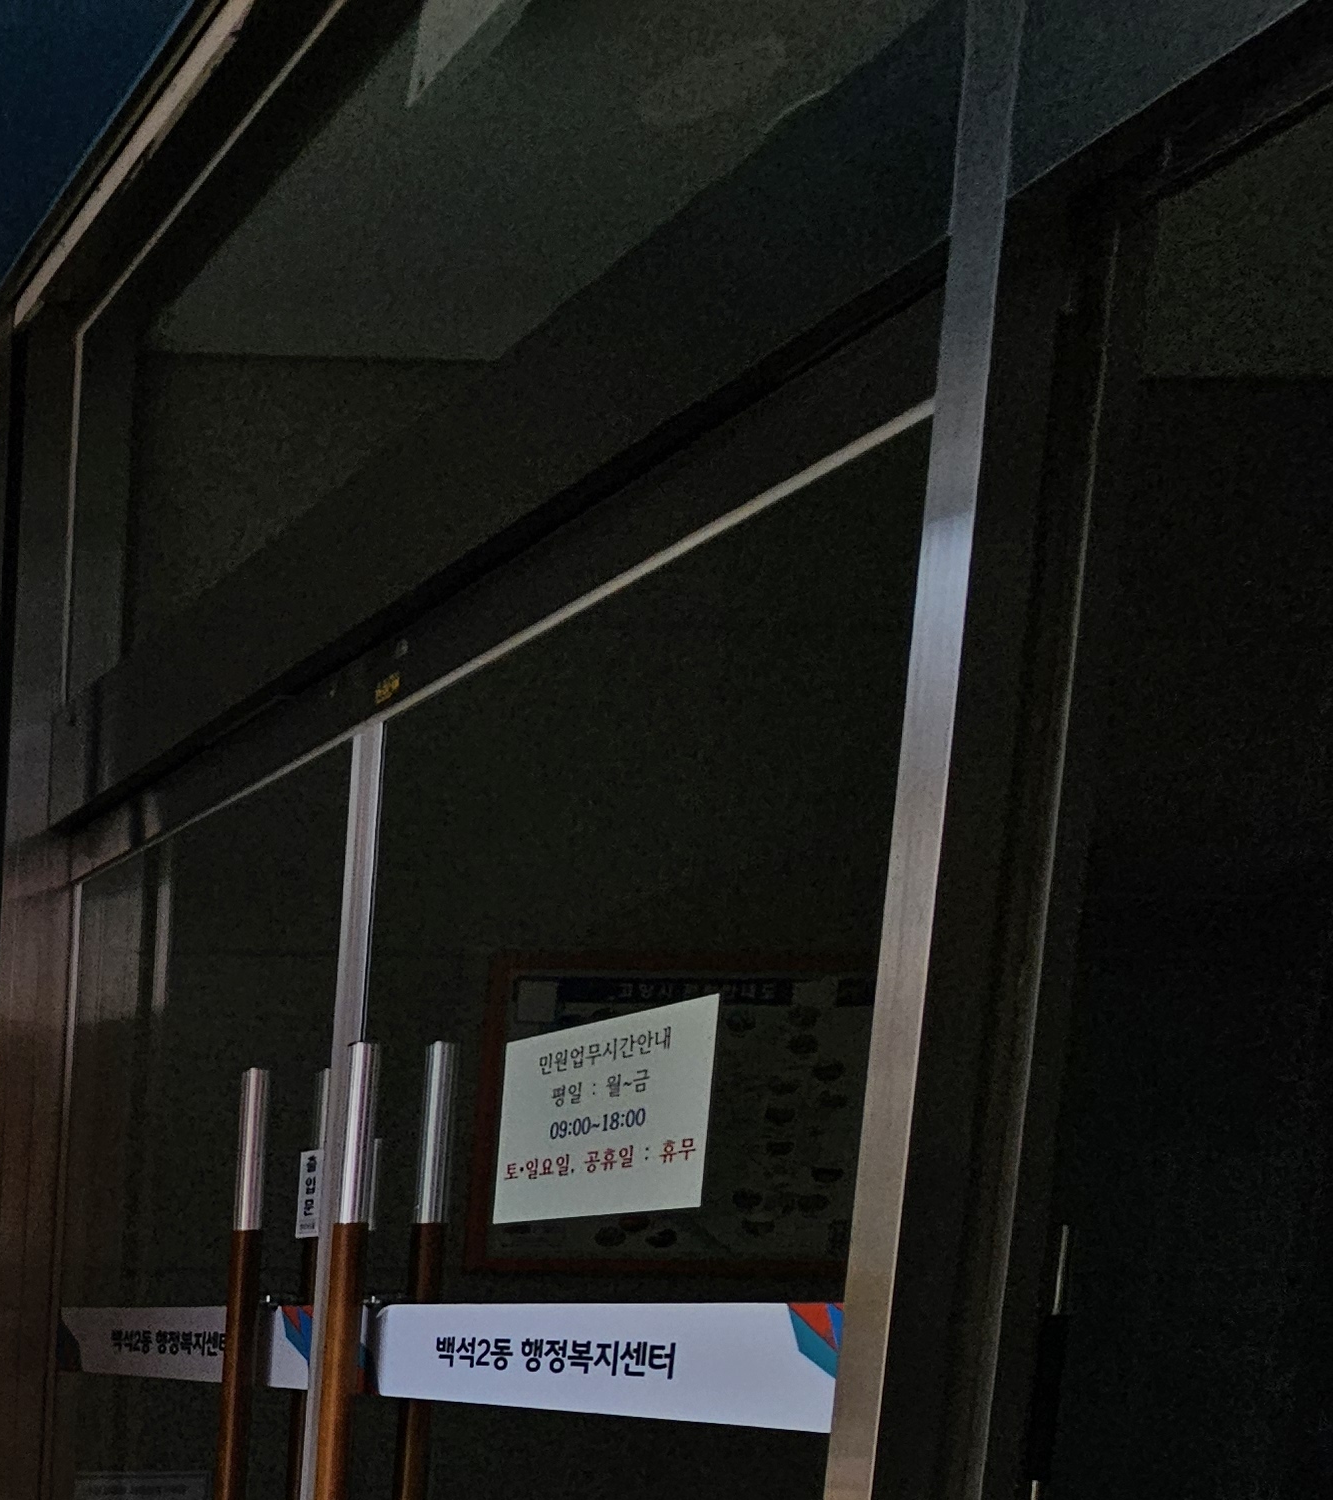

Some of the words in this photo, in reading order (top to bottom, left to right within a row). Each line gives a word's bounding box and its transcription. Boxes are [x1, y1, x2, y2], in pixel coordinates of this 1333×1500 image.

[539, 1026, 672, 1075] 민원업무시간안내
[551, 1082, 583, 1107] 평일
[606, 1069, 651, 1098] 월~금
[549, 1108, 647, 1140] 09:00~18:00
[584, 1145, 634, 1173] 공휴일
[658, 1138, 697, 1164] 휴무
[110, 1329, 153, 1354] 백석2동
[436, 1336, 514, 1371] 백석2동
[521, 1338, 677, 1380] 행정복지센터
